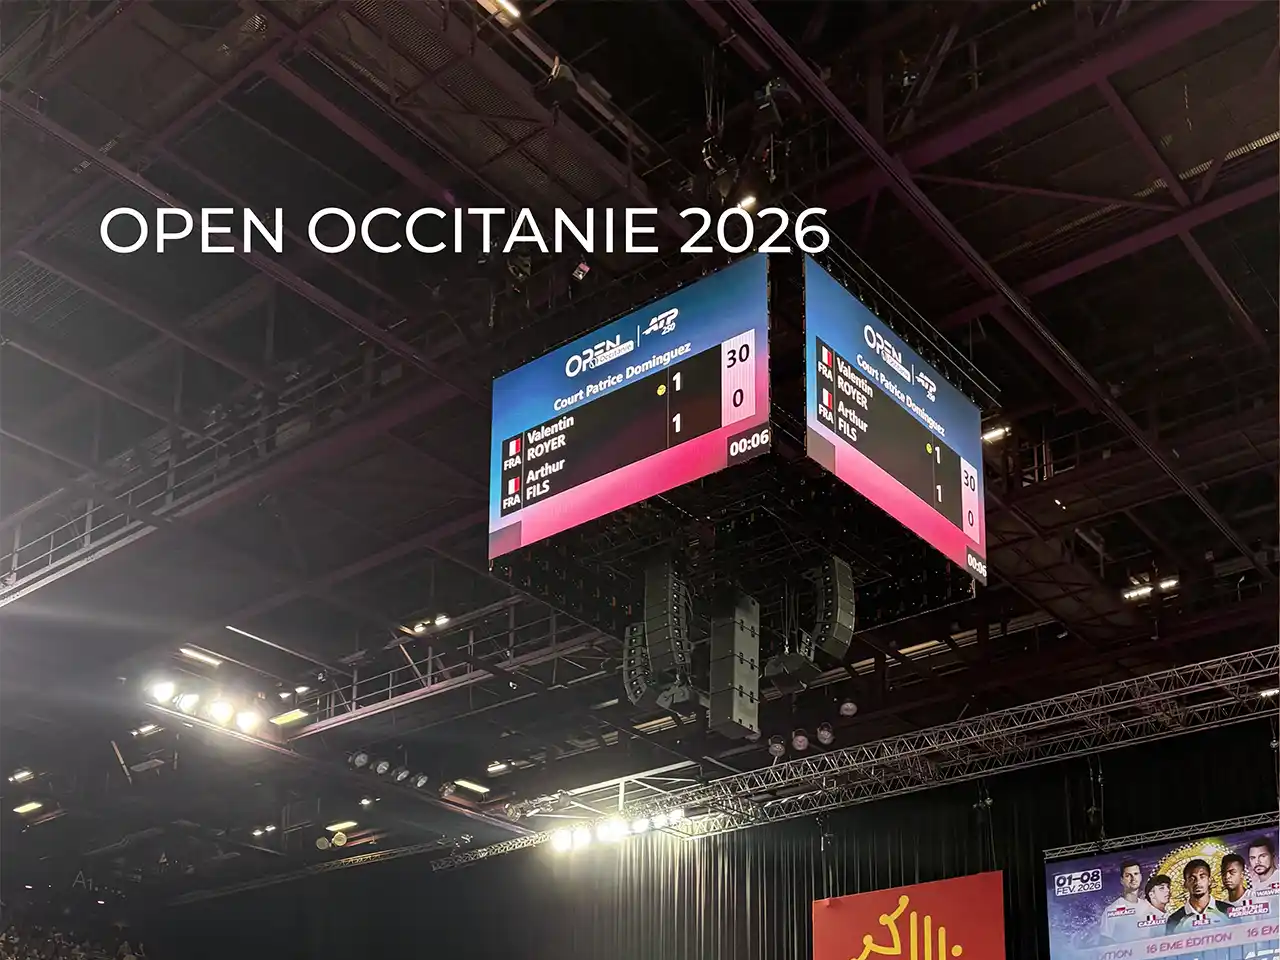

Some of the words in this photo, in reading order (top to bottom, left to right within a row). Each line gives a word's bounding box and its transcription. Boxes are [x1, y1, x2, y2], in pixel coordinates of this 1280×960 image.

[642, 308, 679, 335] ATP
[565, 334, 620, 377] OPEN
[726, 343, 750, 368] 30
[864, 324, 902, 364] OPEN
[553, 389, 584, 411] Court
[586, 373, 623, 397] Patrice
[625, 342, 692, 380] Dominguez
[672, 371, 681, 391] 1
[817, 364, 833, 382] FRA
[836, 357, 873, 398] Valentin
[732, 388, 744, 408] 0
[837, 376, 868, 410] ROYER
[856, 353, 880, 383] Court
[880, 370, 905, 404] Patrice
[905, 391, 945, 437] Dominguez
[672, 413, 681, 433] 1
[818, 405, 834, 425] FRA
[837, 400, 868, 433] Arthur
[527, 415, 575, 444] Valentin
[838, 419, 857, 442] FILS
[527, 434, 566, 461] ROYER
[729, 429, 769, 457] 00:06
[934, 446, 941, 465] 1
[503, 456, 522, 471] FRA
[526, 458, 565, 483] Arthur
[526, 479, 550, 500] FILS
[963, 469, 976, 492] 30
[502, 495, 521, 510] FRA
[936, 485, 943, 503] 1
[967, 510, 974, 528] 0
[967, 552, 987, 578] 00:06
[1077, 882, 1101, 892] 2026
[1146, 940, 1158, 954] 16
[1247, 926, 1258, 939] 16
